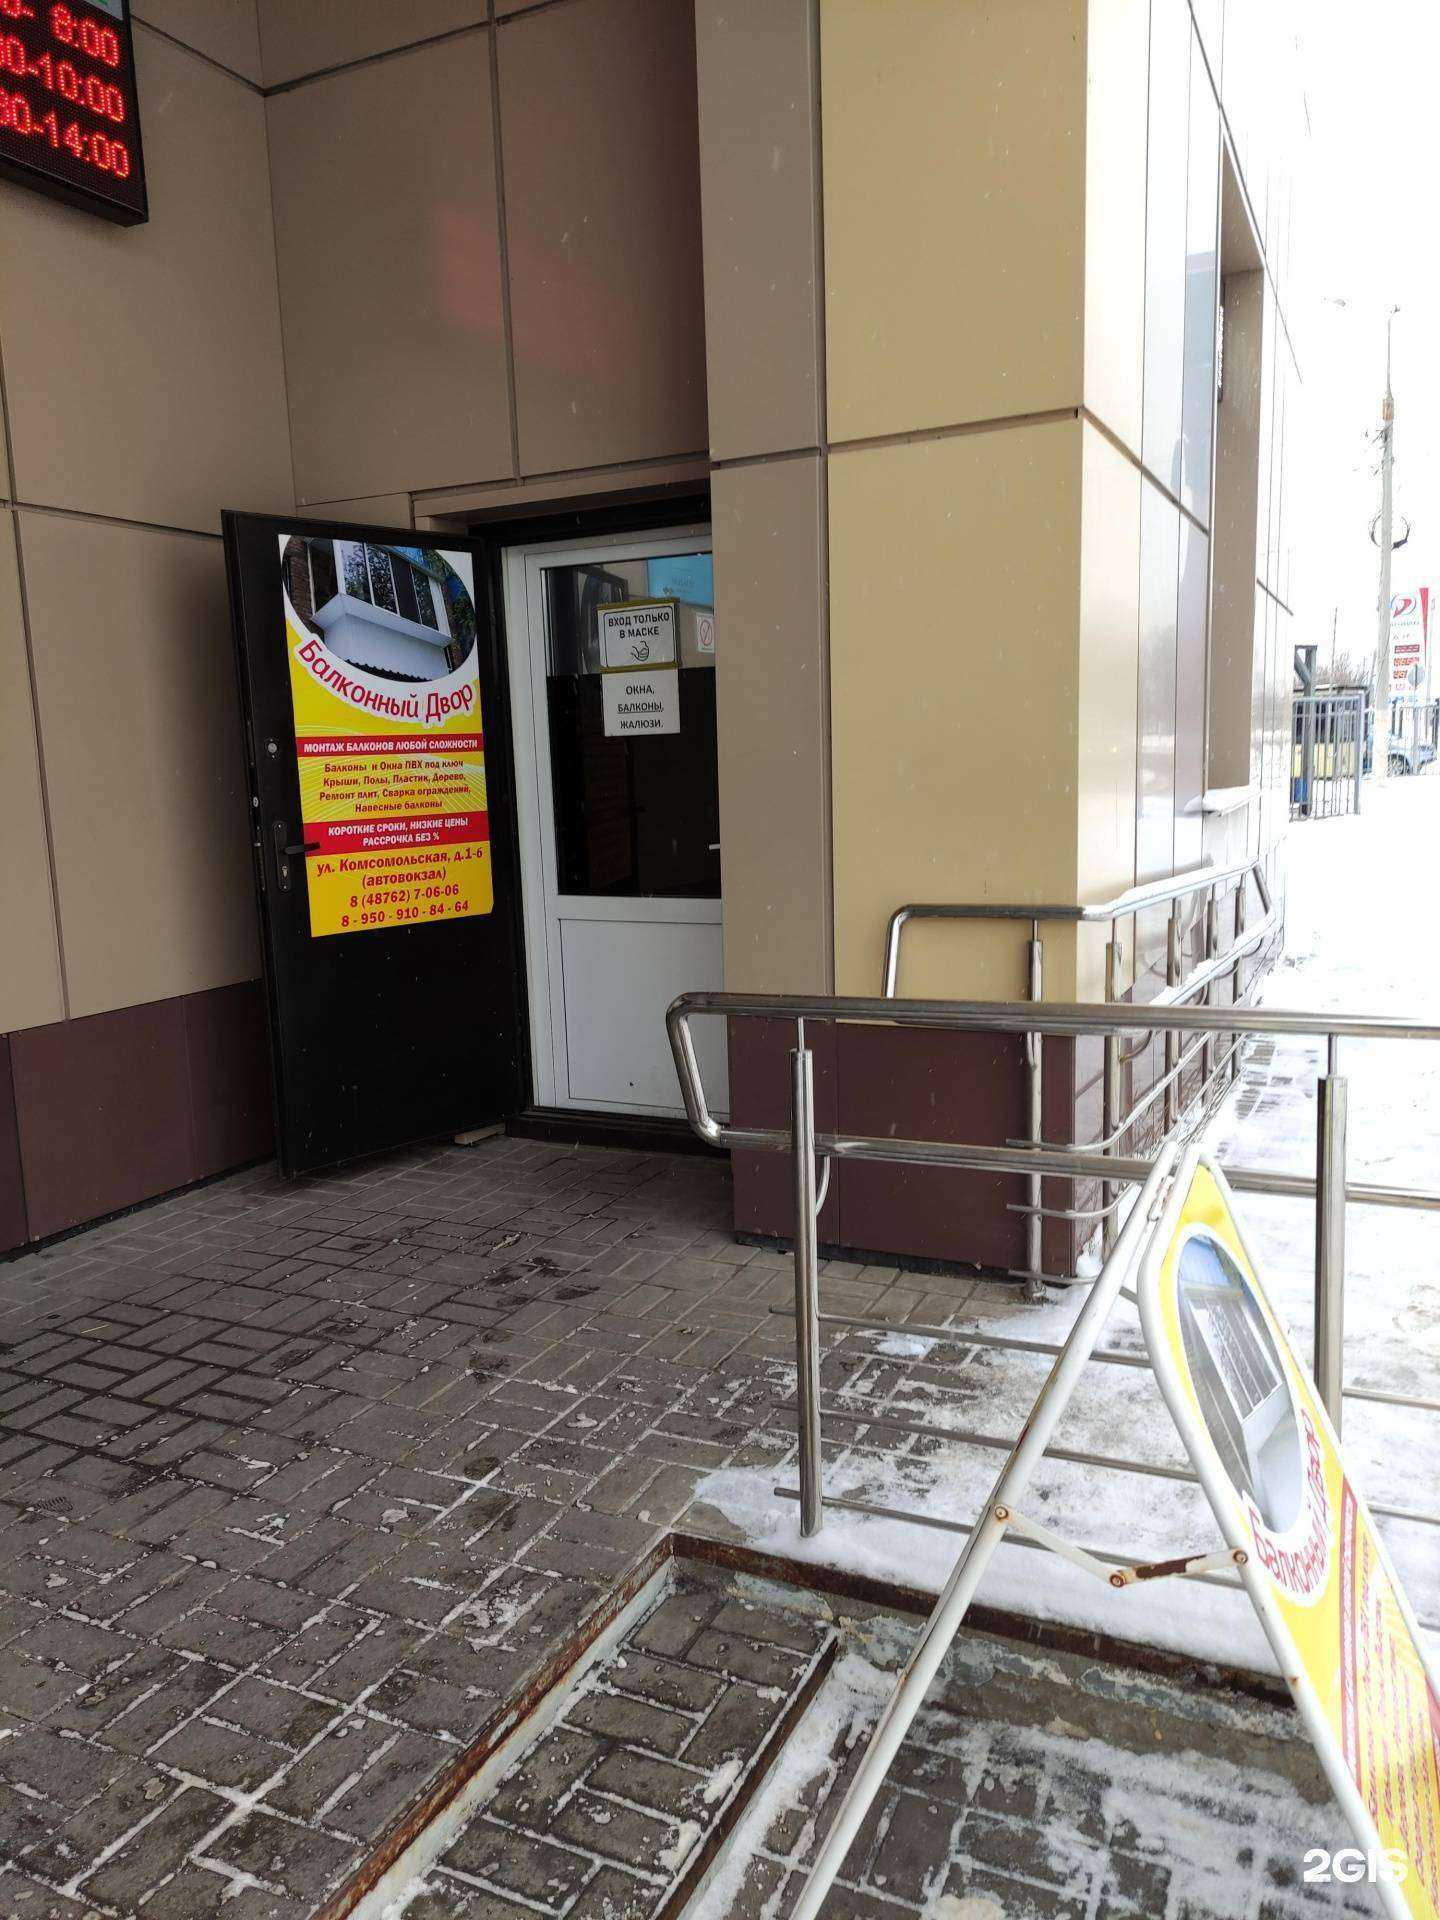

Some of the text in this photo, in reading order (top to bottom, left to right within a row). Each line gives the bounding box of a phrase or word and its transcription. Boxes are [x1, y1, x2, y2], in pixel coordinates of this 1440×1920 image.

[52, 4, 120, 68] 8:00
[0, 35, 126, 124] 0-10:00
[608, 612, 670, 628] ВХОД ТОЛЬКО
[619, 626, 660, 639] В МАСКЕ
[298, 639, 473, 724] Балконный Двор
[625, 684, 655, 696] ОКНА,
[620, 720, 664, 730] ЖАЛЮЗИ.
[303, 738, 478, 753] МОНТАЖ БАЛКОНОВ ЛЮБОЙ СЛОЖНОСТИ
[324, 759, 464, 774] Балконы и Окна ПВХ под ключ
[323, 772, 466, 789] Крыши, Полы, Пластик, Дерево,
[319, 791, 355, 802] Ремонт
[382, 787, 415, 799] Сварка
[355, 799, 443, 814] Навесные балконы
[328, 817, 468, 837] КОРОТКИЕ СРОКИ, НИЗКИЕ ЦЕНЫ
[363, 831, 440, 847] РАССРОЧКА БЕЗ %
[317, 863, 336, 877] ул.
[339, 853, 451, 873] Комсомольская,
[362, 867, 447, 889] (автовокзал)
[350, 884, 460, 909] 8 (48762) 7-06-06
[341, 915, 350, 927] 8
[361, 912, 386, 925] 950
[396, 907, 419, 921] 910
[429, 904, 444, 916] 84
[454, 900, 469, 912] 64
